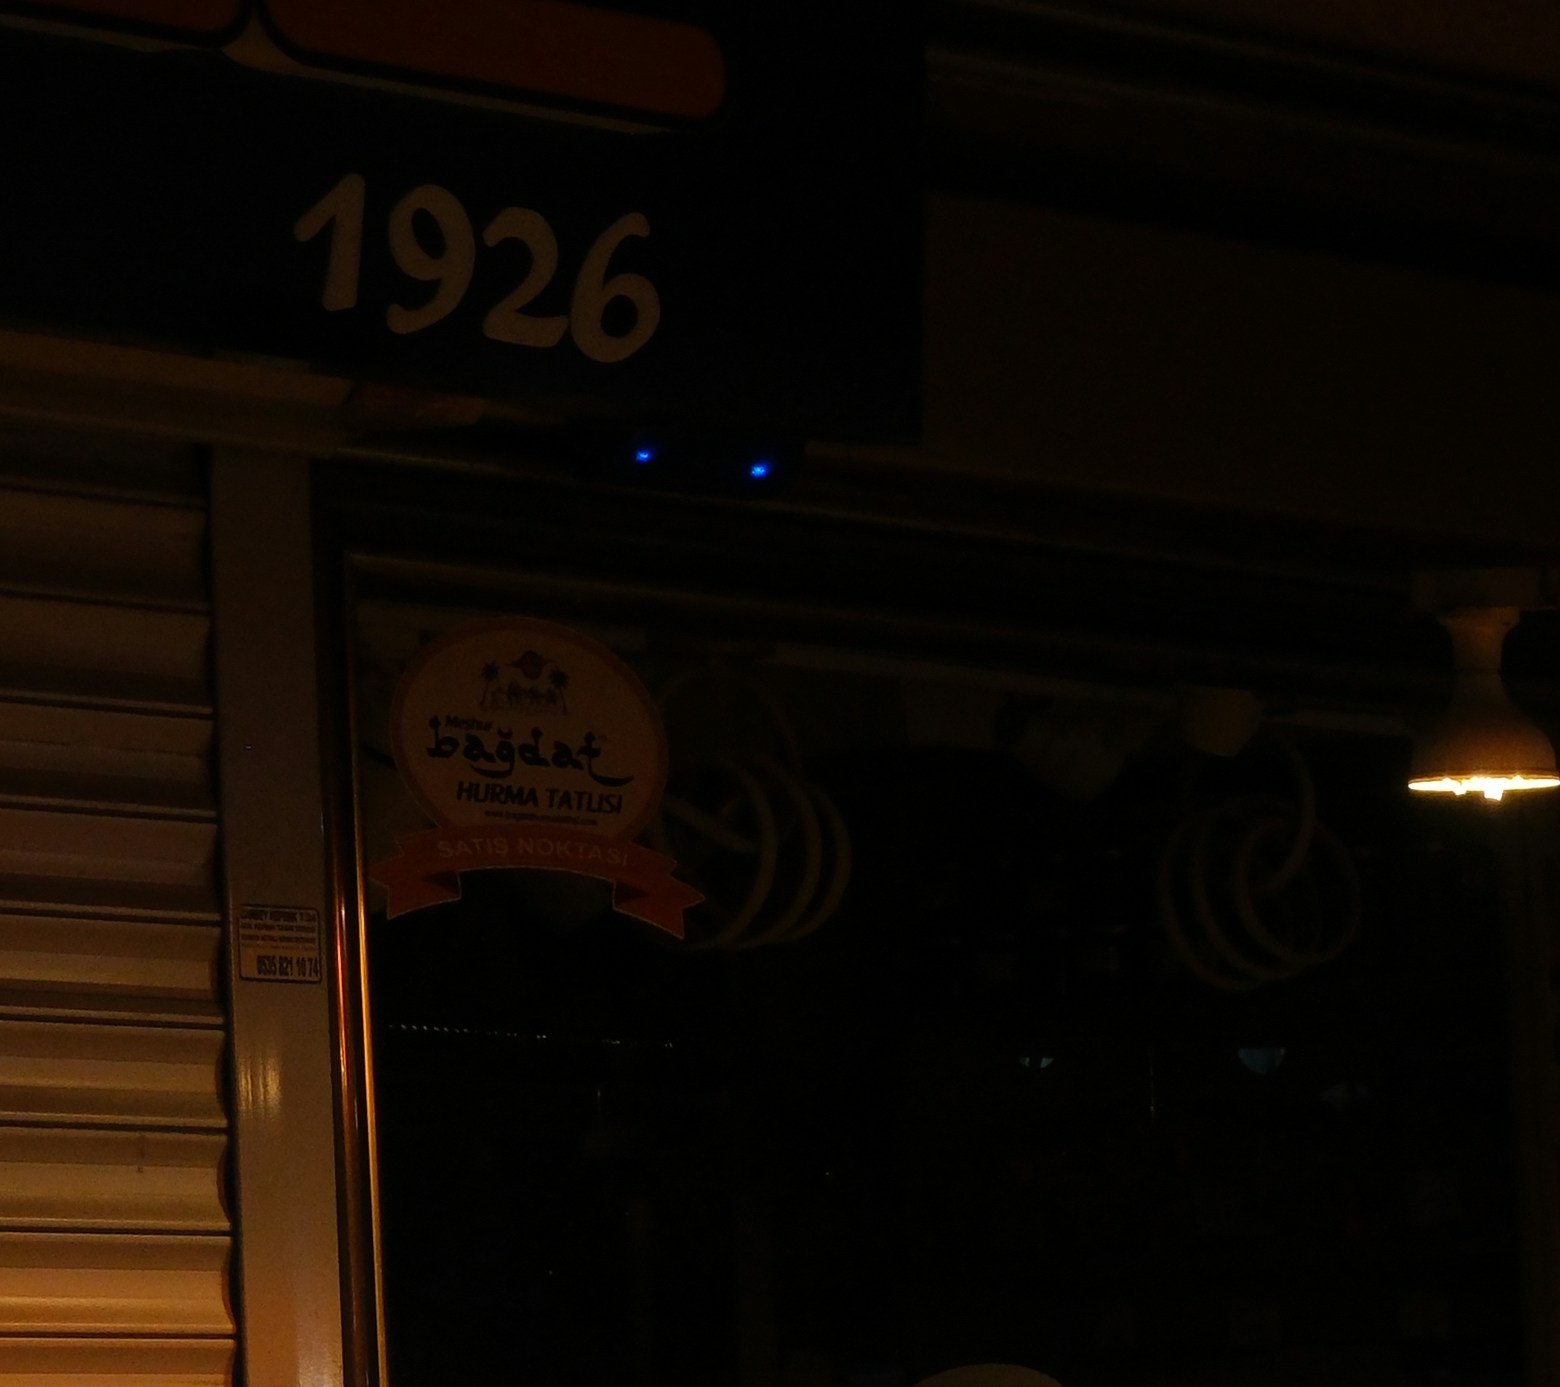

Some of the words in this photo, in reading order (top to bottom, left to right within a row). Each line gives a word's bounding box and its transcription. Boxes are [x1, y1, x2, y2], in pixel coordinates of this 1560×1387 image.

[293, 172, 662, 364] 1926
[457, 780, 539, 808] HURMA
[436, 837, 507, 860] SATIŞ
[517, 837, 628, 867] NOKTASI
